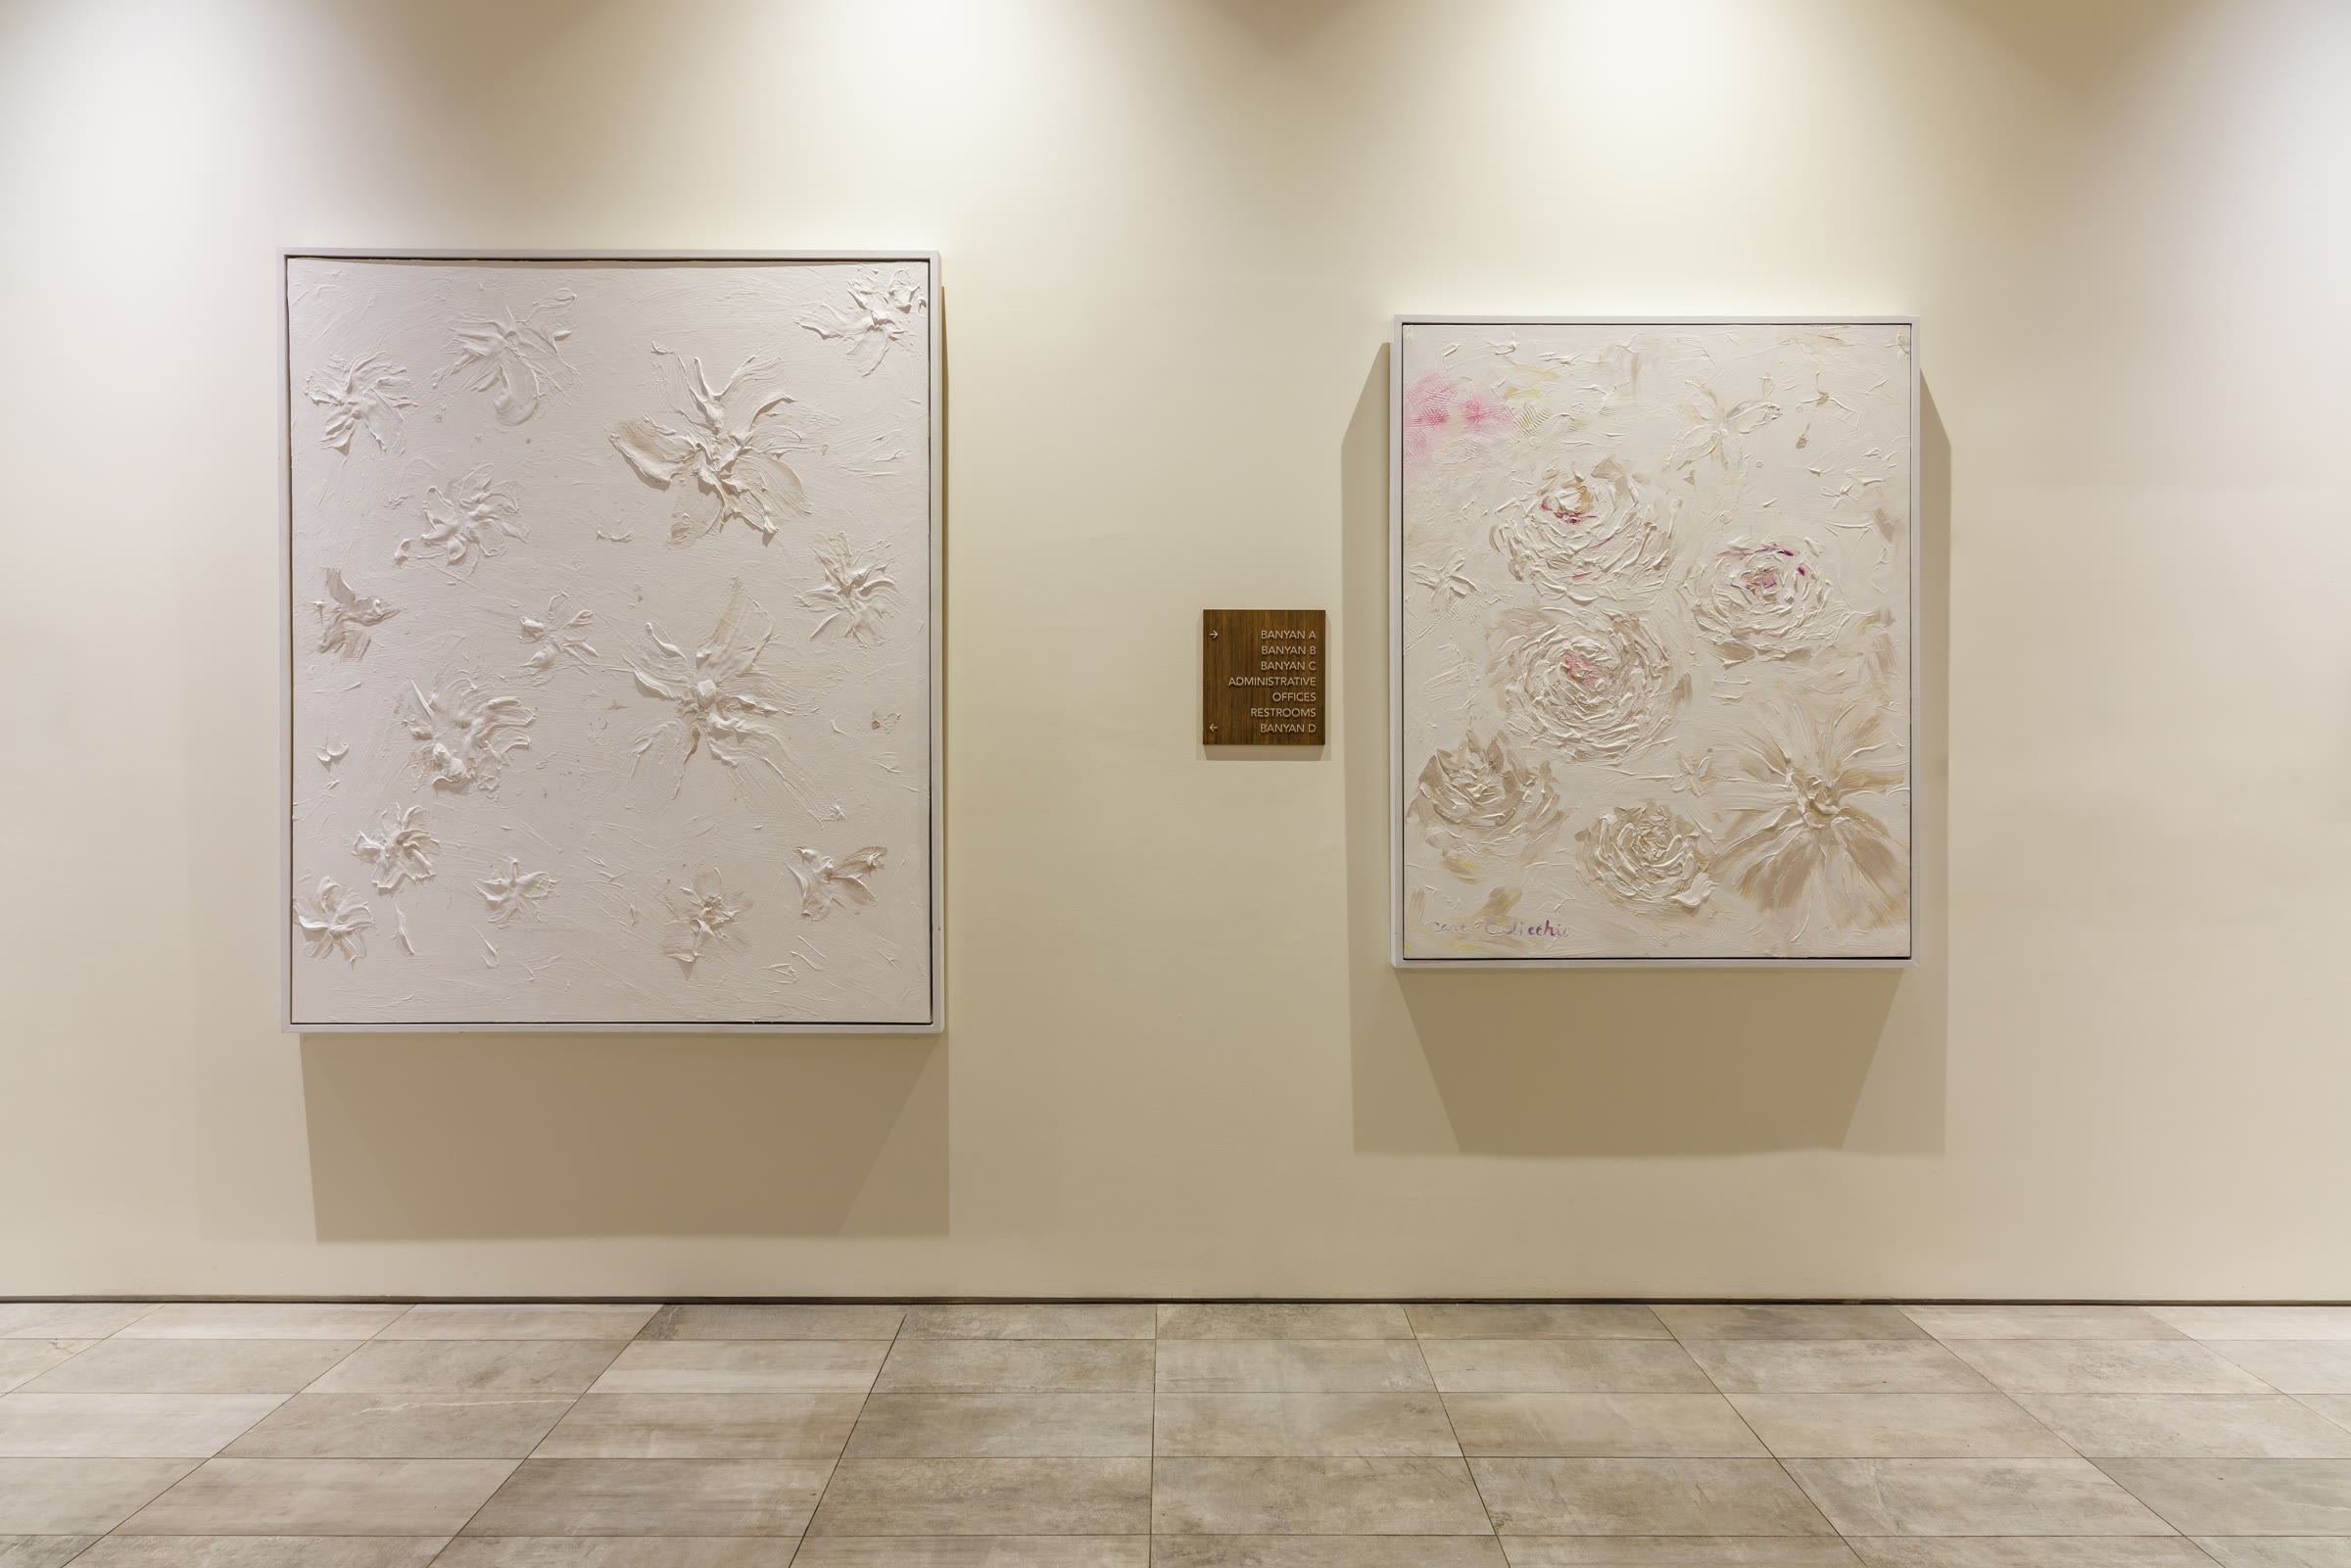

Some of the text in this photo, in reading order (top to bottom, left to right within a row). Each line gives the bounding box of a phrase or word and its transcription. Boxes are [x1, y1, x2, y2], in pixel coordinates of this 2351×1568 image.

[1261, 630, 1317, 640] BANYAN A
[1261, 645, 1317, 655] BANYAN B
[1261, 661, 1317, 671] BANYAN C
[1227, 677, 1317, 687] ADMINISTRATIVE
[1271, 692, 1317, 702] OFFICES
[1250, 708, 1317, 718] RESTROOMS
[1260, 724, 1317, 733] BANYAN D
